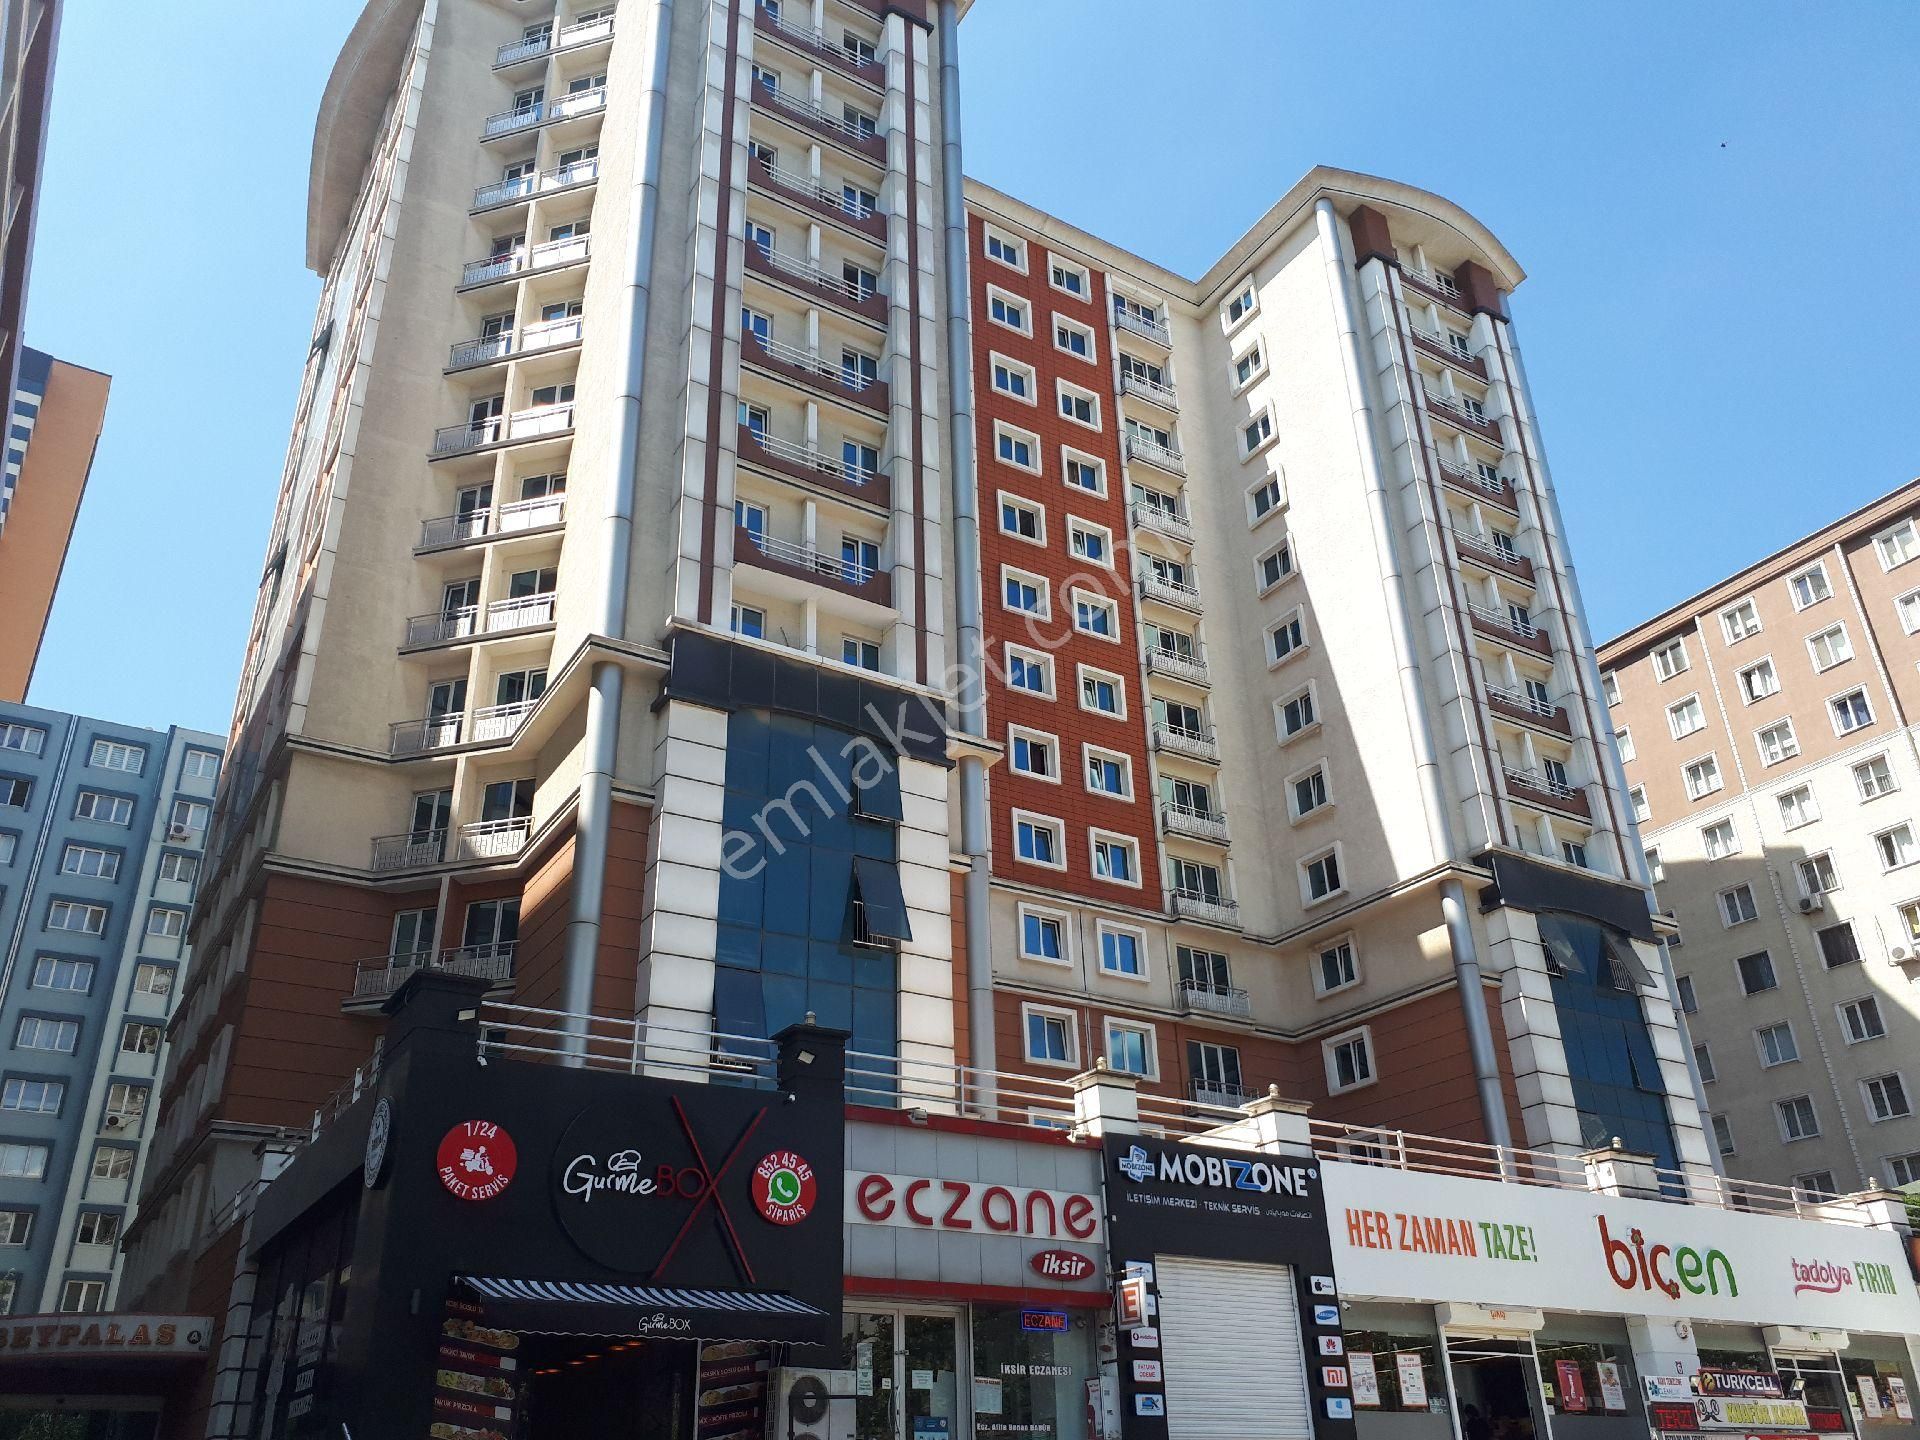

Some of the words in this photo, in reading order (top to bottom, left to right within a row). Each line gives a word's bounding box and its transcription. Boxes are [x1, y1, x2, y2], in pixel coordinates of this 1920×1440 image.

[440, 1166, 469, 1196] PAKET
[757, 1154, 780, 1179] 852
[782, 1152, 797, 1169] 45
[797, 1164, 812, 1181] 45
[1159, 1150, 1308, 1197] MOBIZONE
[765, 1204, 807, 1222] SİPARİŞ
[856, 1174, 1097, 1239] eczane
[1345, 1207, 1393, 1250] HER
[1395, 1212, 1477, 1258] ZAMAN
[1478, 1221, 1538, 1262] TAZE!
[1042, 1253, 1086, 1276] iksir
[1854, 1260, 1898, 1295] FIRIN
[1024, 1313, 1065, 1329] ECZANE
[1713, 1374, 1778, 1391] TURKCELL
